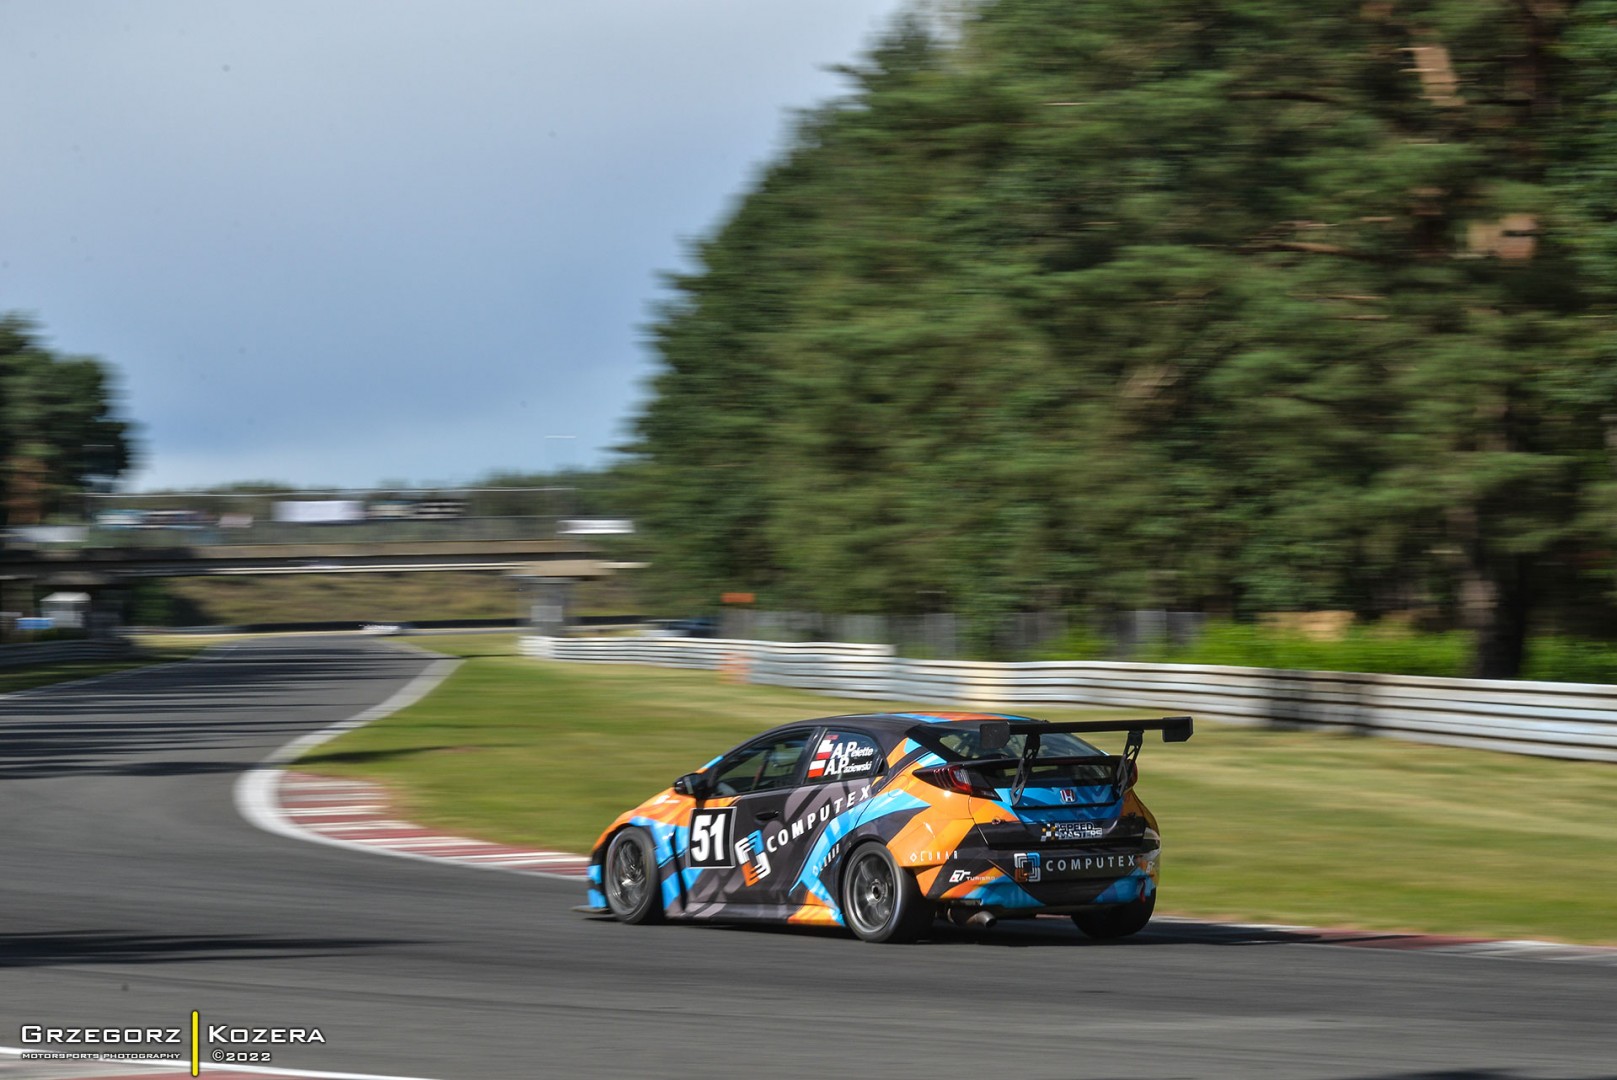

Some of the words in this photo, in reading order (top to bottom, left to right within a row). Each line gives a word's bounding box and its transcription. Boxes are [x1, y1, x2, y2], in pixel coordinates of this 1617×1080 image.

[766, 784, 872, 853] COMPUTEX
[1058, 822, 1094, 832] SPEED
[691, 813, 726, 862] 51
[1045, 854, 1136, 872] COMPUTEX
